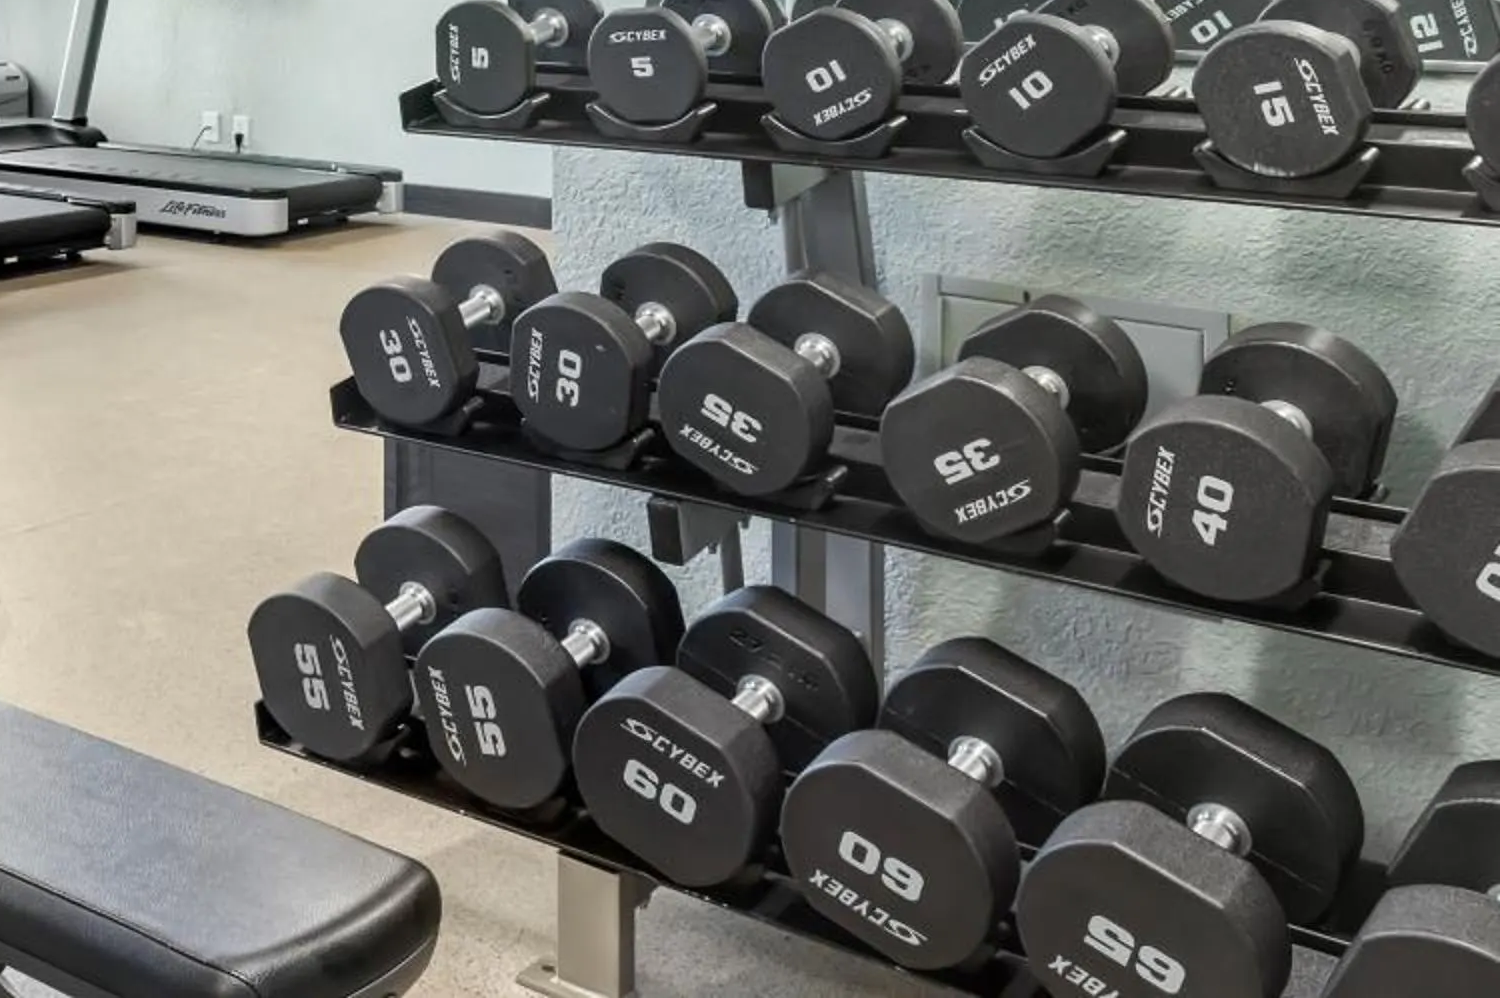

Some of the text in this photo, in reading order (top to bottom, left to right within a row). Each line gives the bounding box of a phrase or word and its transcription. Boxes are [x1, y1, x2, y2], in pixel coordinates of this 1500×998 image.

[471, 47, 488, 69] 5
[627, 29, 666, 42] CYBEX
[994, 33, 1036, 73] CYBEX
[631, 57, 654, 77] 5
[805, 59, 846, 92] 10
[1008, 70, 1053, 110] 10
[813, 97, 855, 126] CYBEX
[1253, 80, 1295, 127] 15
[1305, 83, 1339, 135] CYBEX
[379, 329, 412, 383] 30
[415, 340, 441, 388] CYBEX
[528, 327, 543, 381] CYBEX
[556, 349, 582, 407] 30
[679, 423, 734, 462] CYBEX
[700, 393, 762, 443] 35
[933, 438, 1001, 485] 35
[1150, 445, 1176, 511] CYBEX
[954, 489, 1009, 525] CYBEX
[1191, 475, 1234, 546] 40
[294, 642, 330, 711] 55
[338, 663, 364, 730] CYBEX
[427, 665, 459, 735] CYBEX
[464, 685, 507, 757] 55
[652, 735, 725, 789] CYBEX
[623, 759, 698, 825] 60
[838, 831, 925, 902] 60
[808, 869, 890, 926] CYBEX
[1083, 914, 1186, 995] 65
